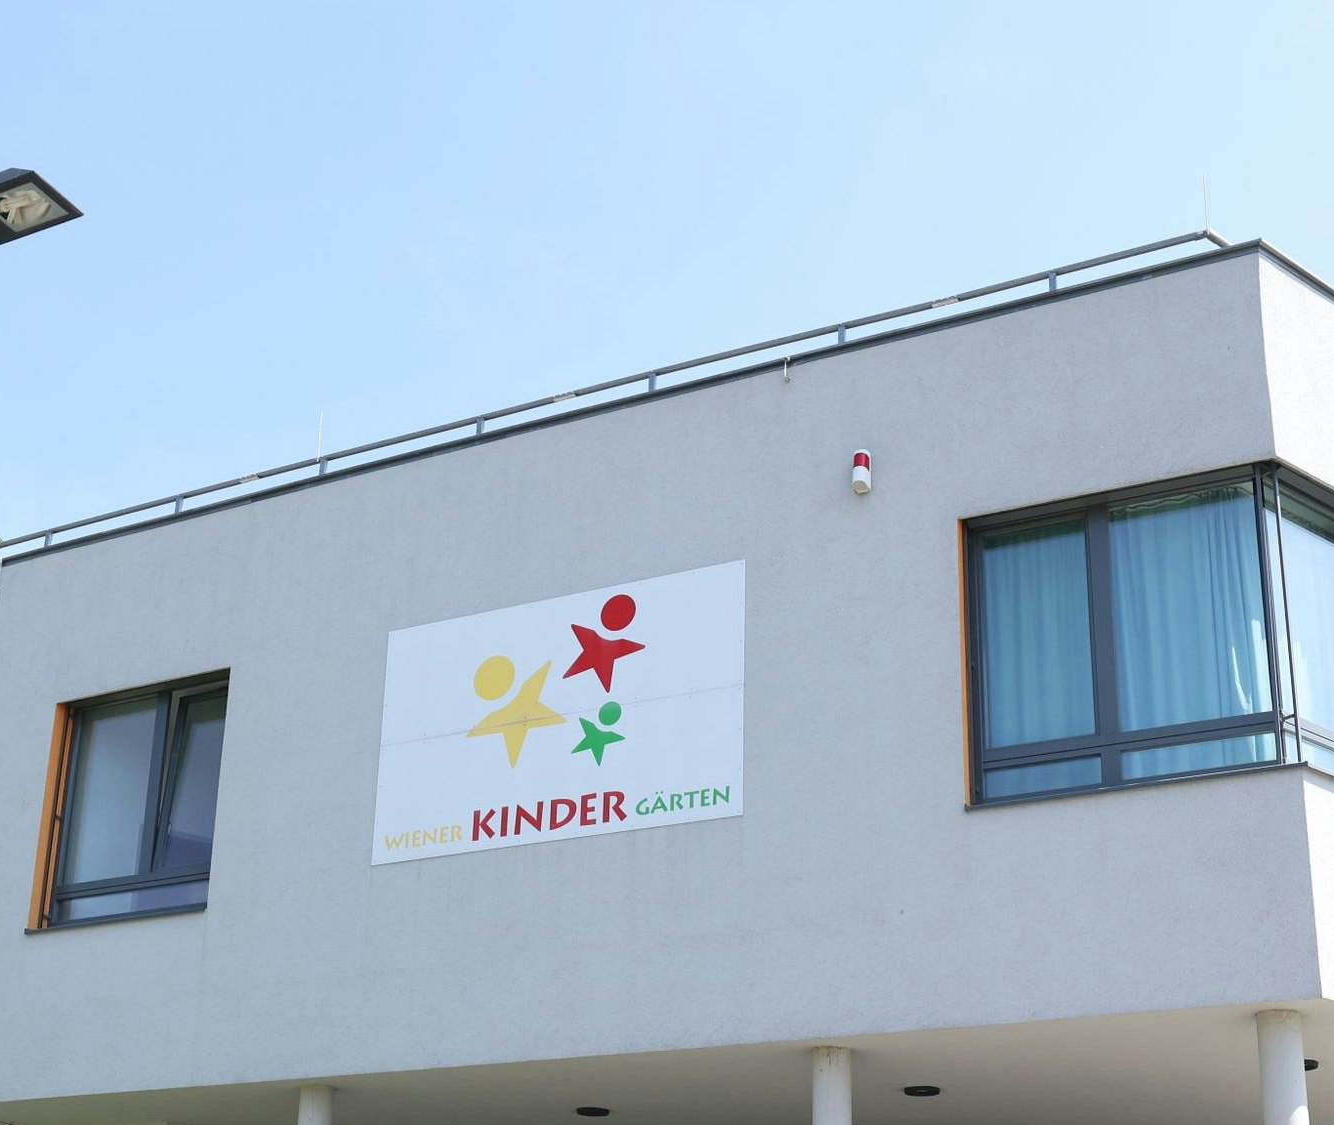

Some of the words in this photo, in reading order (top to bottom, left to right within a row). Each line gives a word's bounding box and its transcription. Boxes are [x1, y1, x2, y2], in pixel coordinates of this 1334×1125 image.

[384, 826, 463, 852] WIENER
[471, 791, 627, 841] KINDER
[635, 786, 731, 816] GÄRTEN
